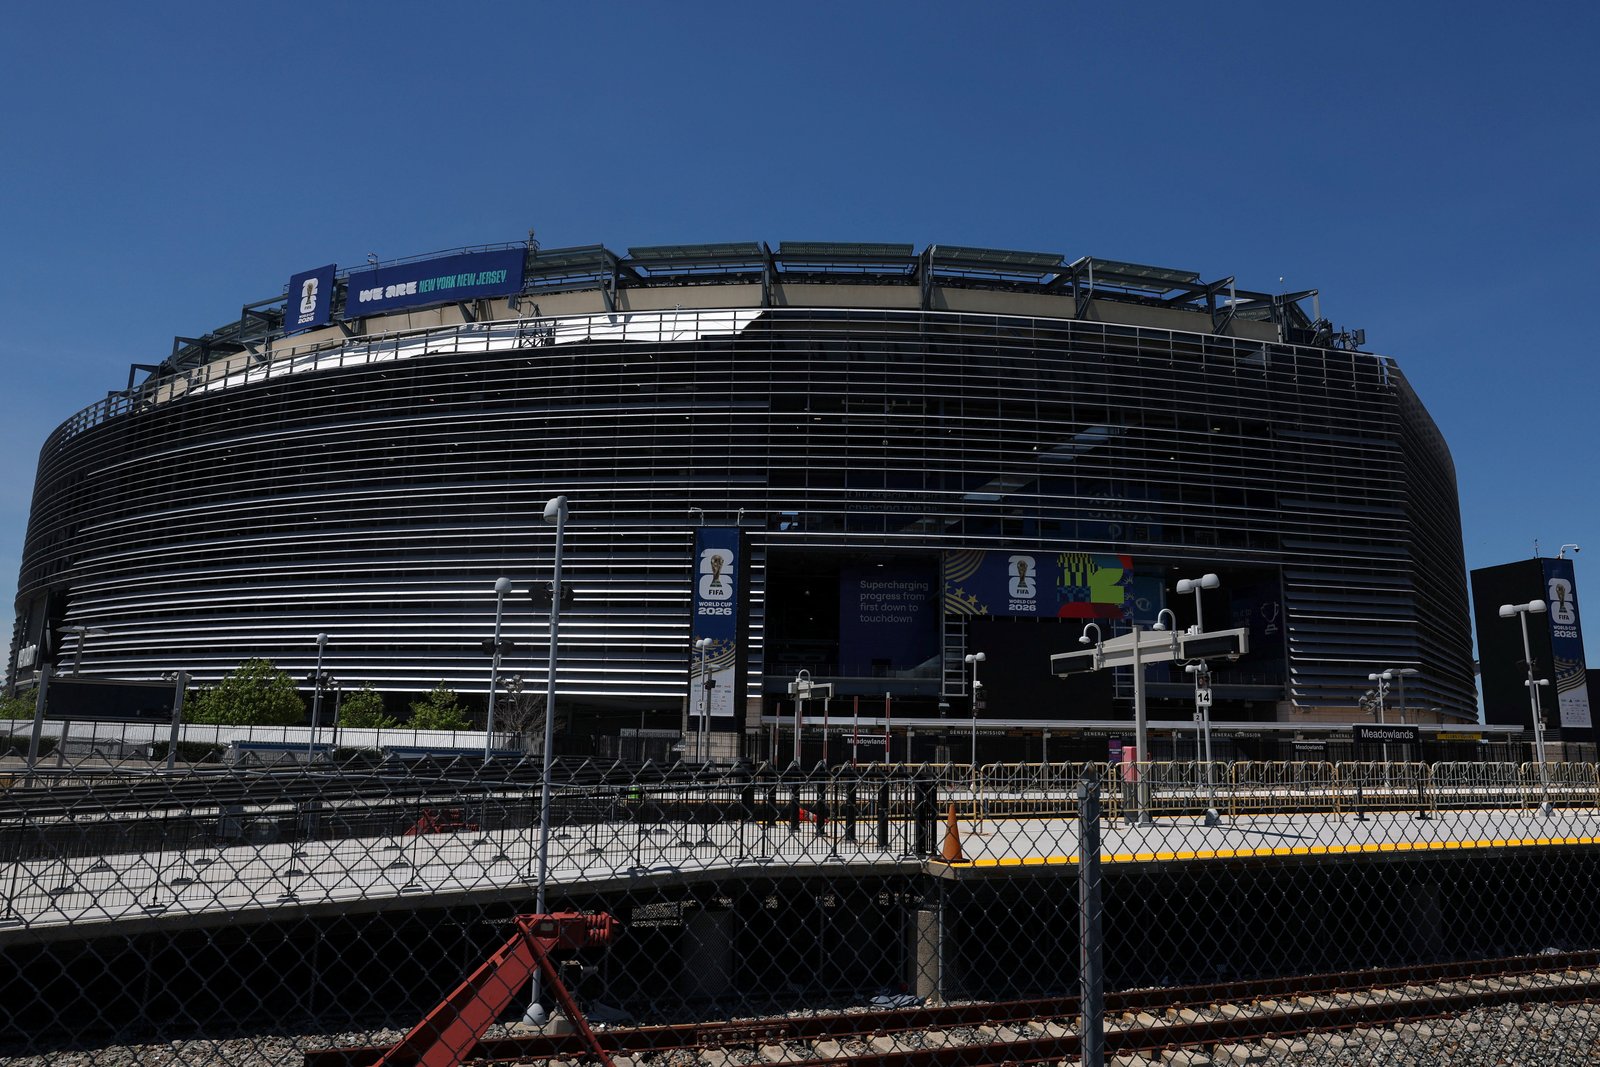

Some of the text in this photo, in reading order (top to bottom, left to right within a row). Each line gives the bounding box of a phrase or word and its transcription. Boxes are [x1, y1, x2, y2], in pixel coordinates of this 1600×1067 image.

[359, 269, 507, 303] WE ARE NEW YORK NEW JERSEY
[860, 580, 929, 592] Supercharging
[860, 592, 925, 602] progress from
[698, 607, 732, 616] 2026
[860, 602, 919, 612] first down to
[860, 614, 913, 623] touchdown
[1553, 630, 1578, 639] 2026
[1198, 693, 1210, 702] 14
[1361, 728, 1414, 739] Meadowlands
